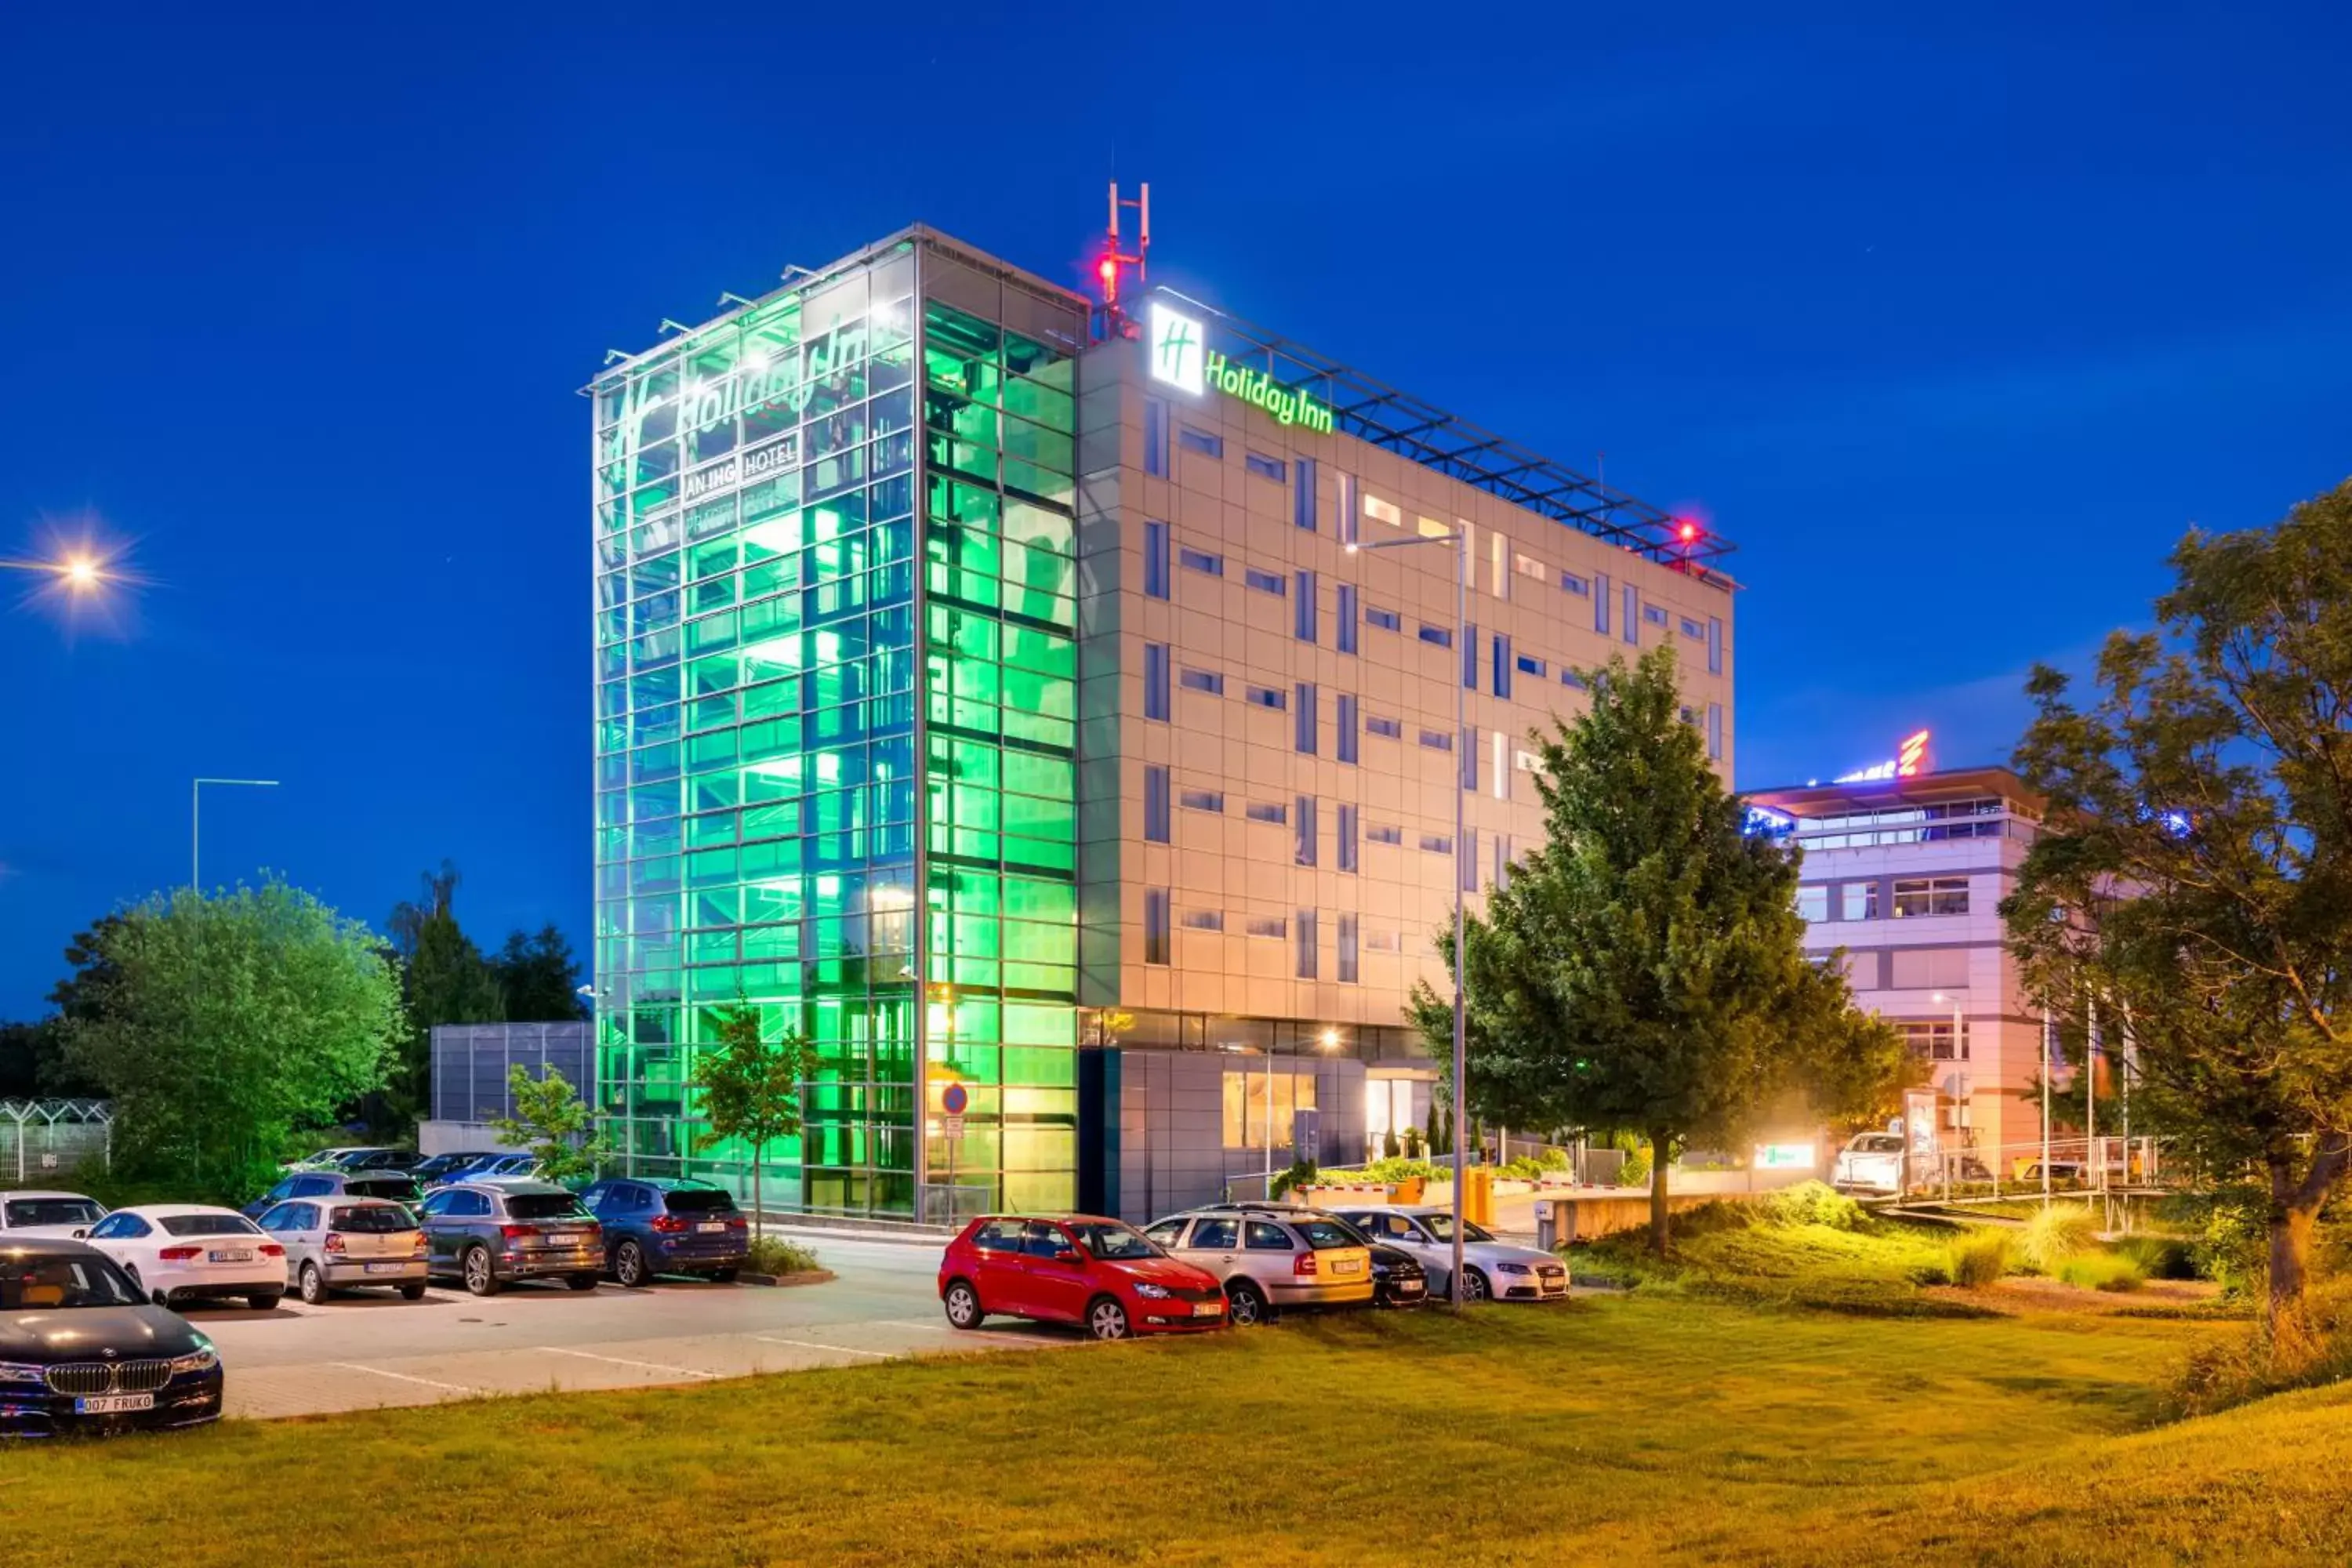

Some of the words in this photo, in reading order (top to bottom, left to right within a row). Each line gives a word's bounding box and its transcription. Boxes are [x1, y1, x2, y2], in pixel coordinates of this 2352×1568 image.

[675, 346, 819, 444] Holiday
[1204, 350, 1296, 424] Holiday
[1298, 388, 1332, 434] Inn
[686, 473, 706, 499] AN
[708, 463, 735, 489] IHG
[746, 441, 796, 475] HOTEL
[85, 1399, 107, 1412] 007
